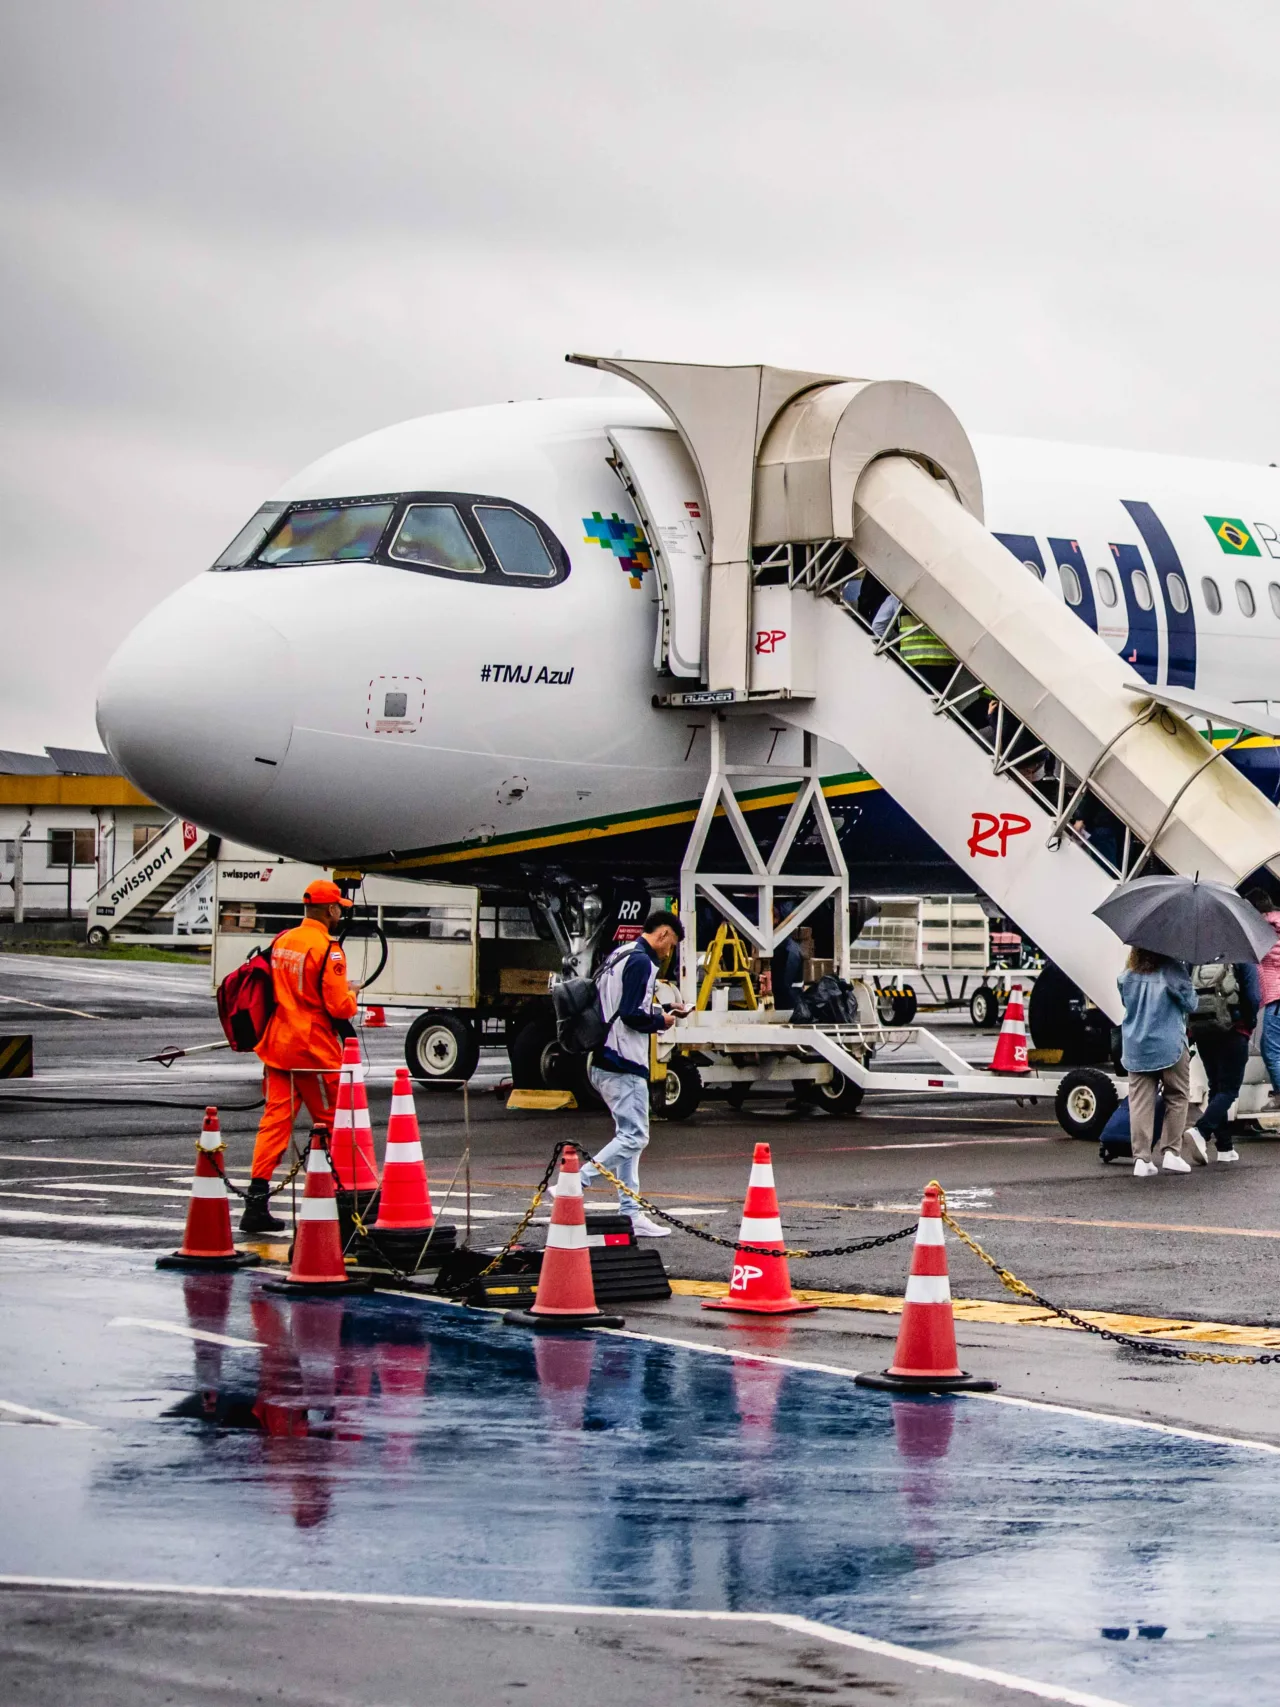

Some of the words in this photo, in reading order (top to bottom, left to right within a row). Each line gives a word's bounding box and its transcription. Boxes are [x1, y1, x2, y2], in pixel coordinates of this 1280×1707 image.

[755, 630, 786, 654] RP
[480, 664, 533, 683] #TMJ
[534, 665, 575, 684] Azul
[967, 812, 1031, 858] RP
[111, 846, 173, 905] swissport
[222, 868, 261, 880] swissport
[617, 900, 641, 919] RR
[731, 1265, 763, 1290] RP
